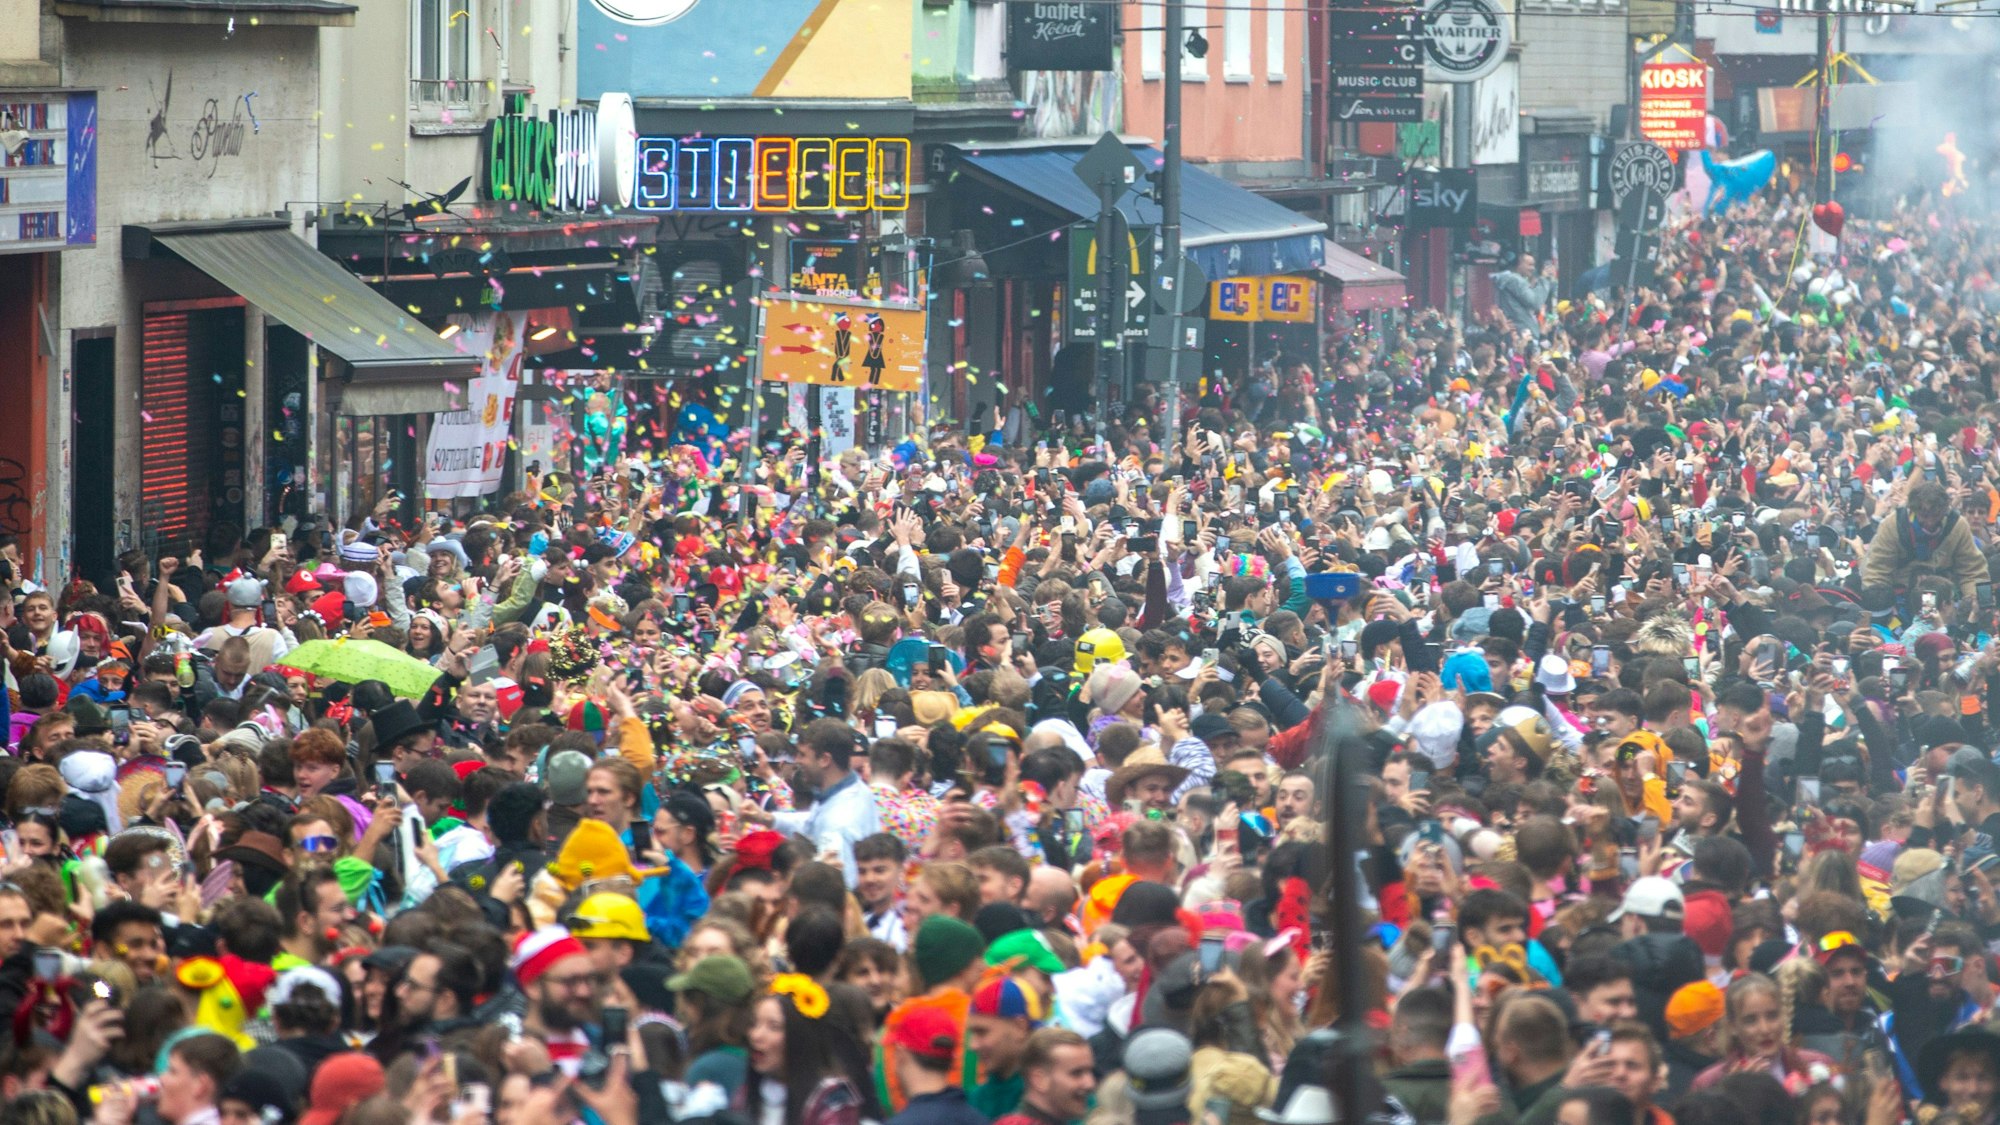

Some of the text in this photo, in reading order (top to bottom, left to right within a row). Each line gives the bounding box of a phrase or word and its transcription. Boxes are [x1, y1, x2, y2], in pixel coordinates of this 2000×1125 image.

[1032, 20, 1086, 41] Kölsch
[1338, 76, 1417, 88] MUSIC CLUB
[1640, 68, 1704, 88] KIOSK
[1614, 144, 1670, 170] FRISEUR
[640, 146, 904, 201] STIEFEL
[1416, 181, 1469, 213] sky
[790, 273, 849, 290] FANTA
